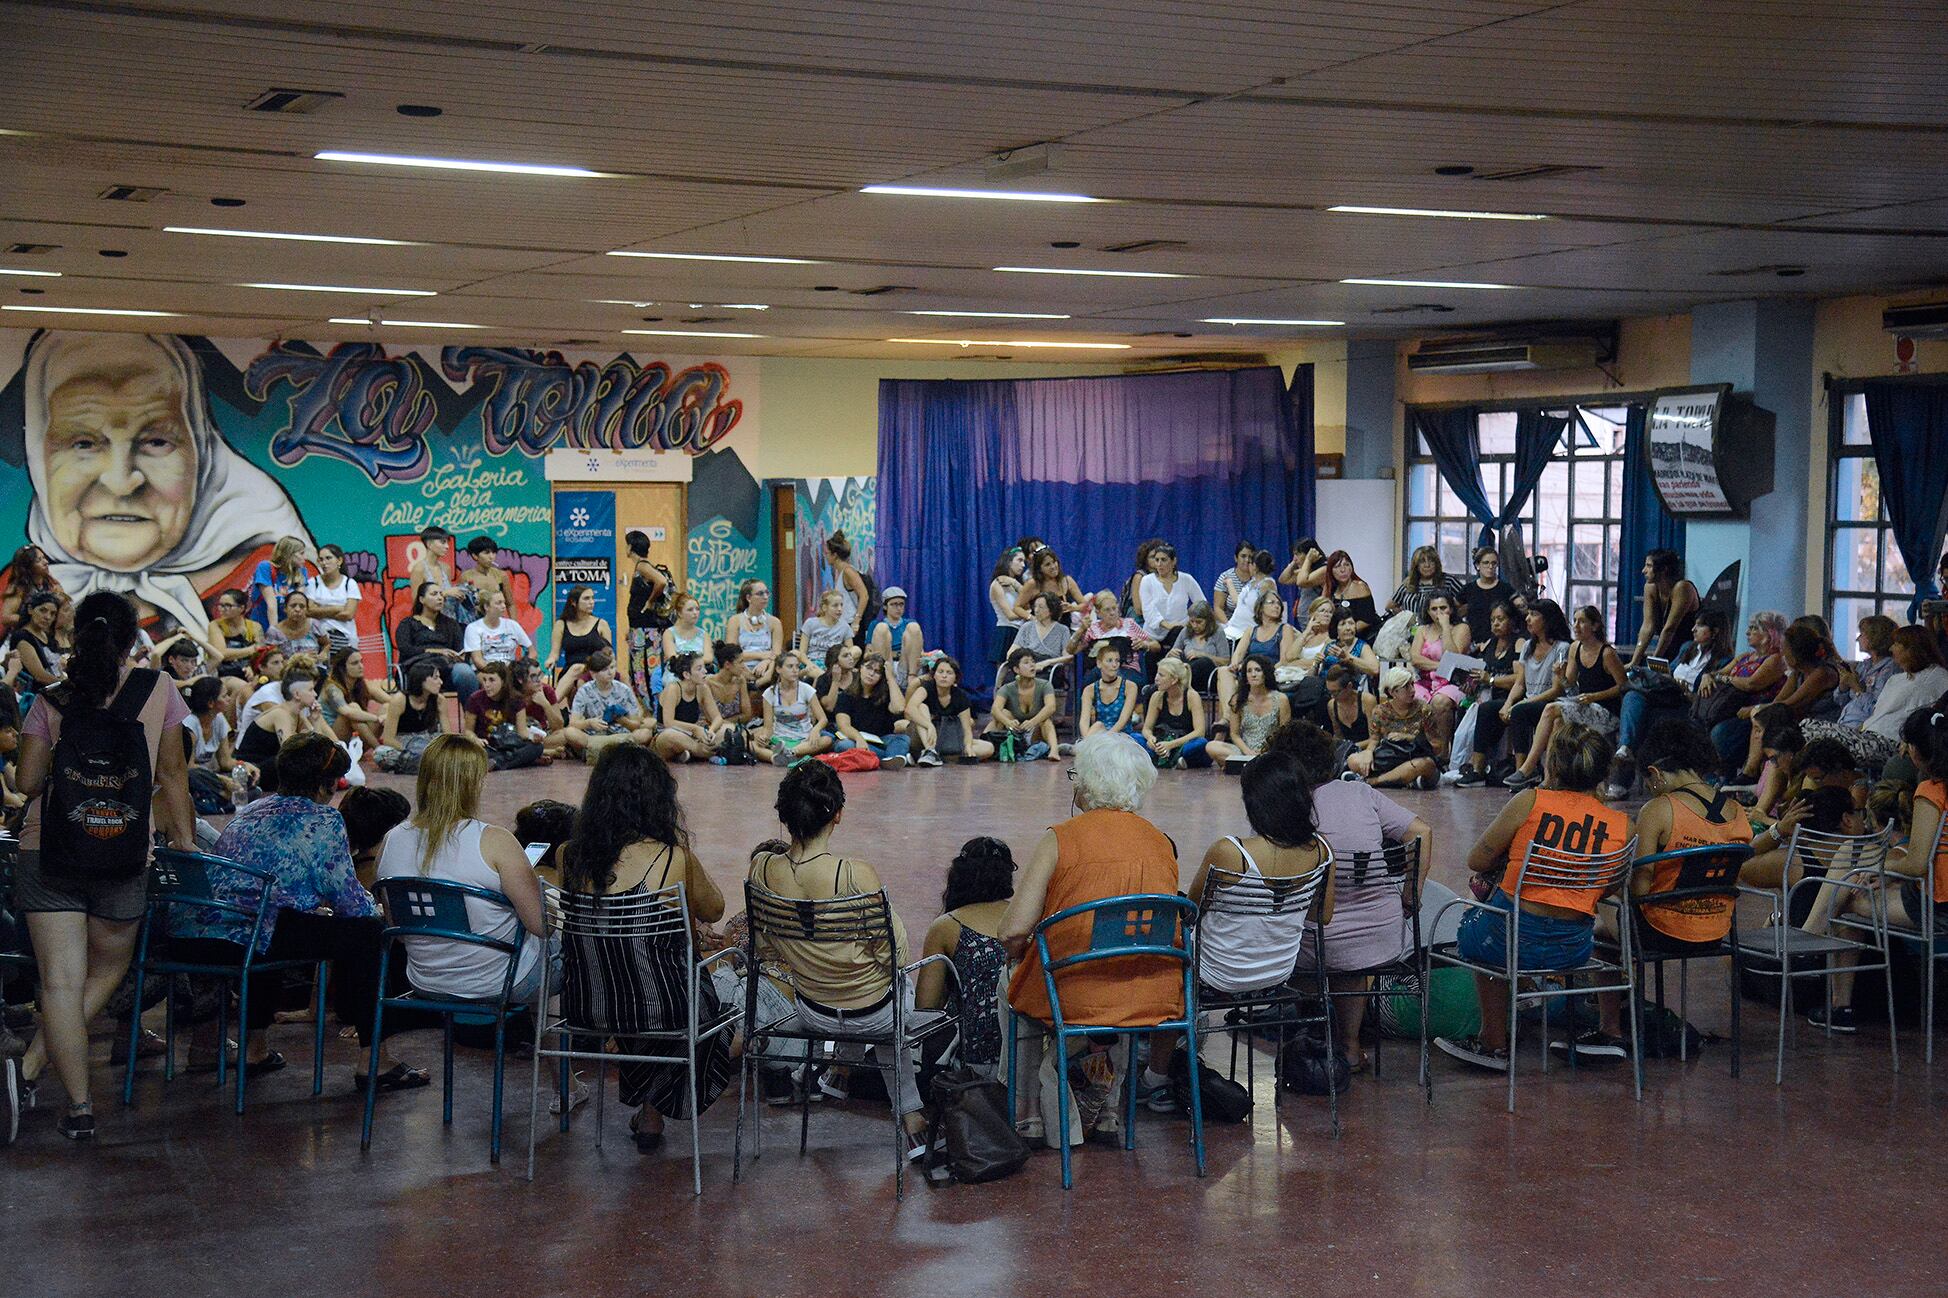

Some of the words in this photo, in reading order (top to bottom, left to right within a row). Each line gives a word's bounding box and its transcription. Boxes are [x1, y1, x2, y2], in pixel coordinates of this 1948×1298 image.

[381, 501, 424, 527] Calle
[555, 560, 573, 568] entro
[573, 559, 598, 567] cultural
[599, 559, 608, 567] de
[1531, 811, 1609, 856] pdt
